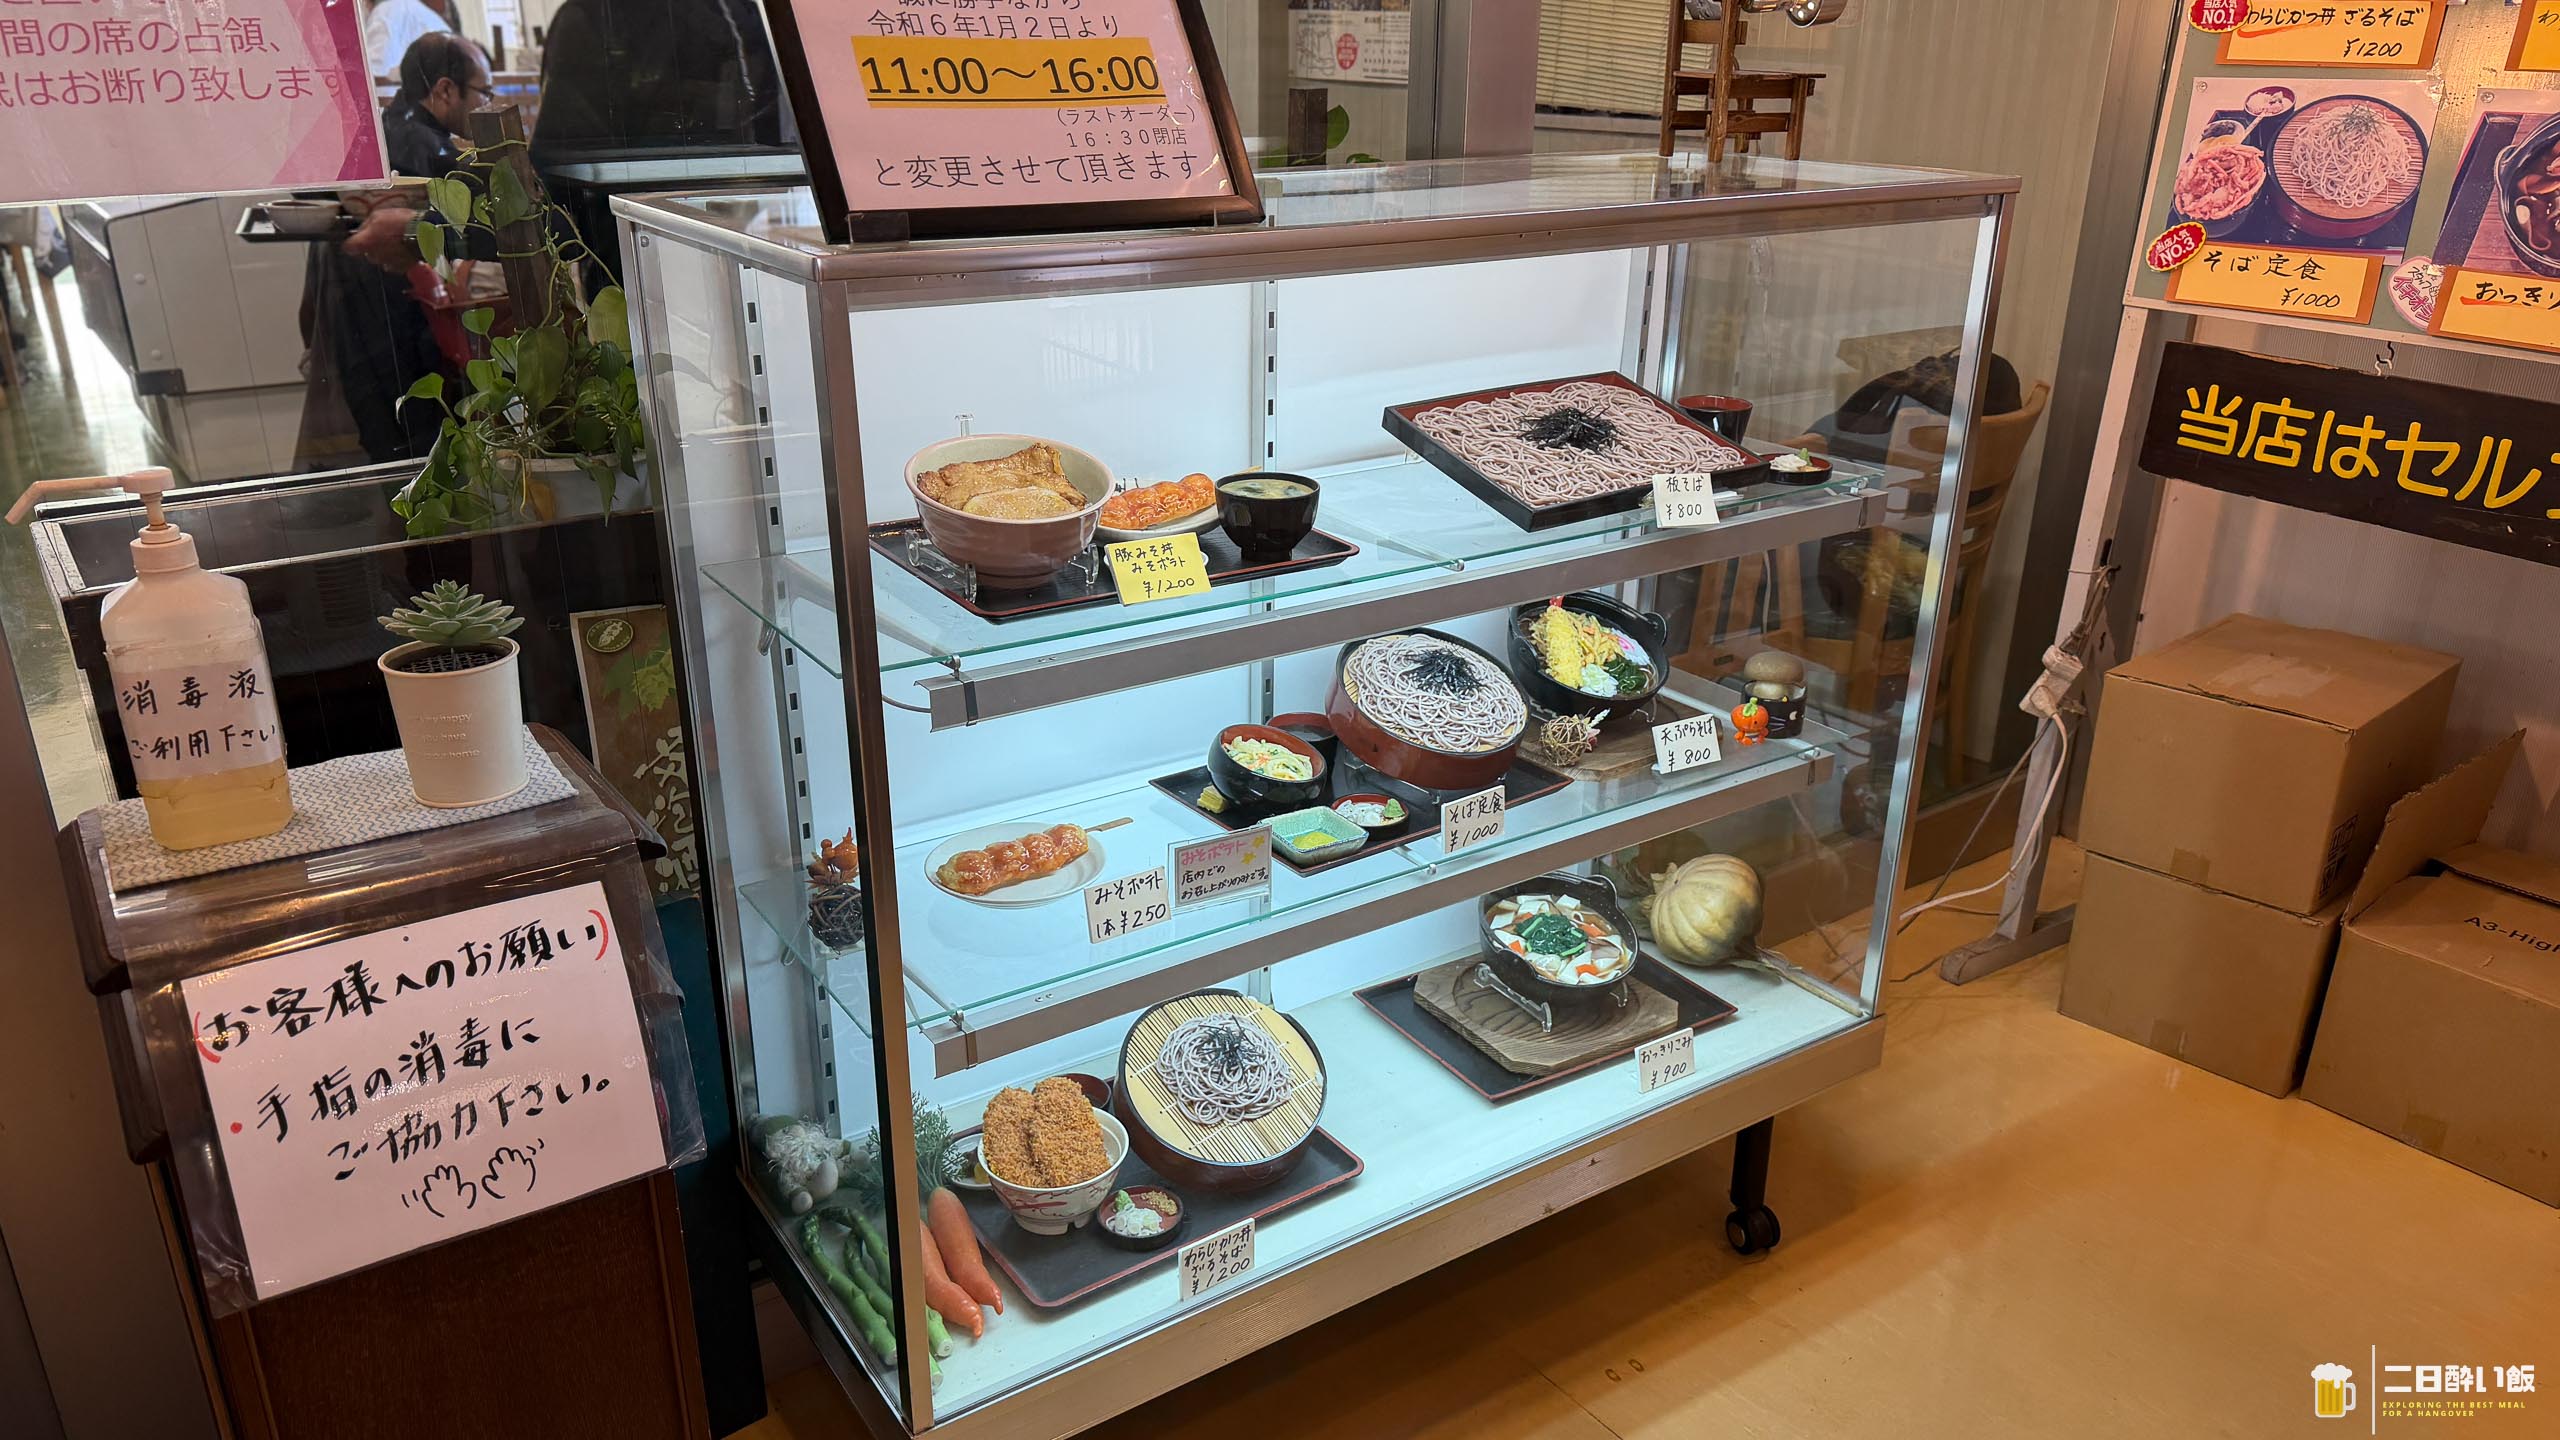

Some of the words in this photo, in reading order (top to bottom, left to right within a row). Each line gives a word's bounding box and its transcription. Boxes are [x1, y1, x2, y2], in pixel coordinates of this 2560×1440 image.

[2201, 9, 2235, 24] NO.1
[2344, 7, 2425, 27] ざるそば
[2343, 38, 2402, 58] ¥1200
[877, 151, 1198, 189] と変更させて頂きます
[2156, 229, 2190, 252] 当店人気
[2159, 237, 2195, 266] NO.3
[2204, 250, 2326, 281] そば定食
[2281, 288, 2341, 308] ¥1000
[2177, 384, 2560, 519] 当店はセル
[1666, 476, 1704, 493] 板そば
[1666, 503, 1702, 520] ¥800
[1114, 542, 1173, 562] 豚みそ丼
[122, 668, 264, 715] 消毒液
[131, 724, 276, 761] ご利用下さい
[1661, 715, 1714, 745] 天ぷらそば
[1668, 748, 1711, 773] ¥800
[1449, 791, 1503, 824] そば定食
[1450, 823, 1499, 853] ¥1000
[1181, 840, 1248, 866] みそポテト
[1095, 870, 1164, 905] みそポテト
[1182, 865, 1226, 885] 店内での
[1641, 1036, 1692, 1064] おっきりこみ
[1651, 1062, 1687, 1090] ¥900
[327, 1072, 611, 1181] ご協力下さい。
[1184, 1225, 1251, 1267] わらじかつ丼
[1191, 1258, 1250, 1296] ¥1200
